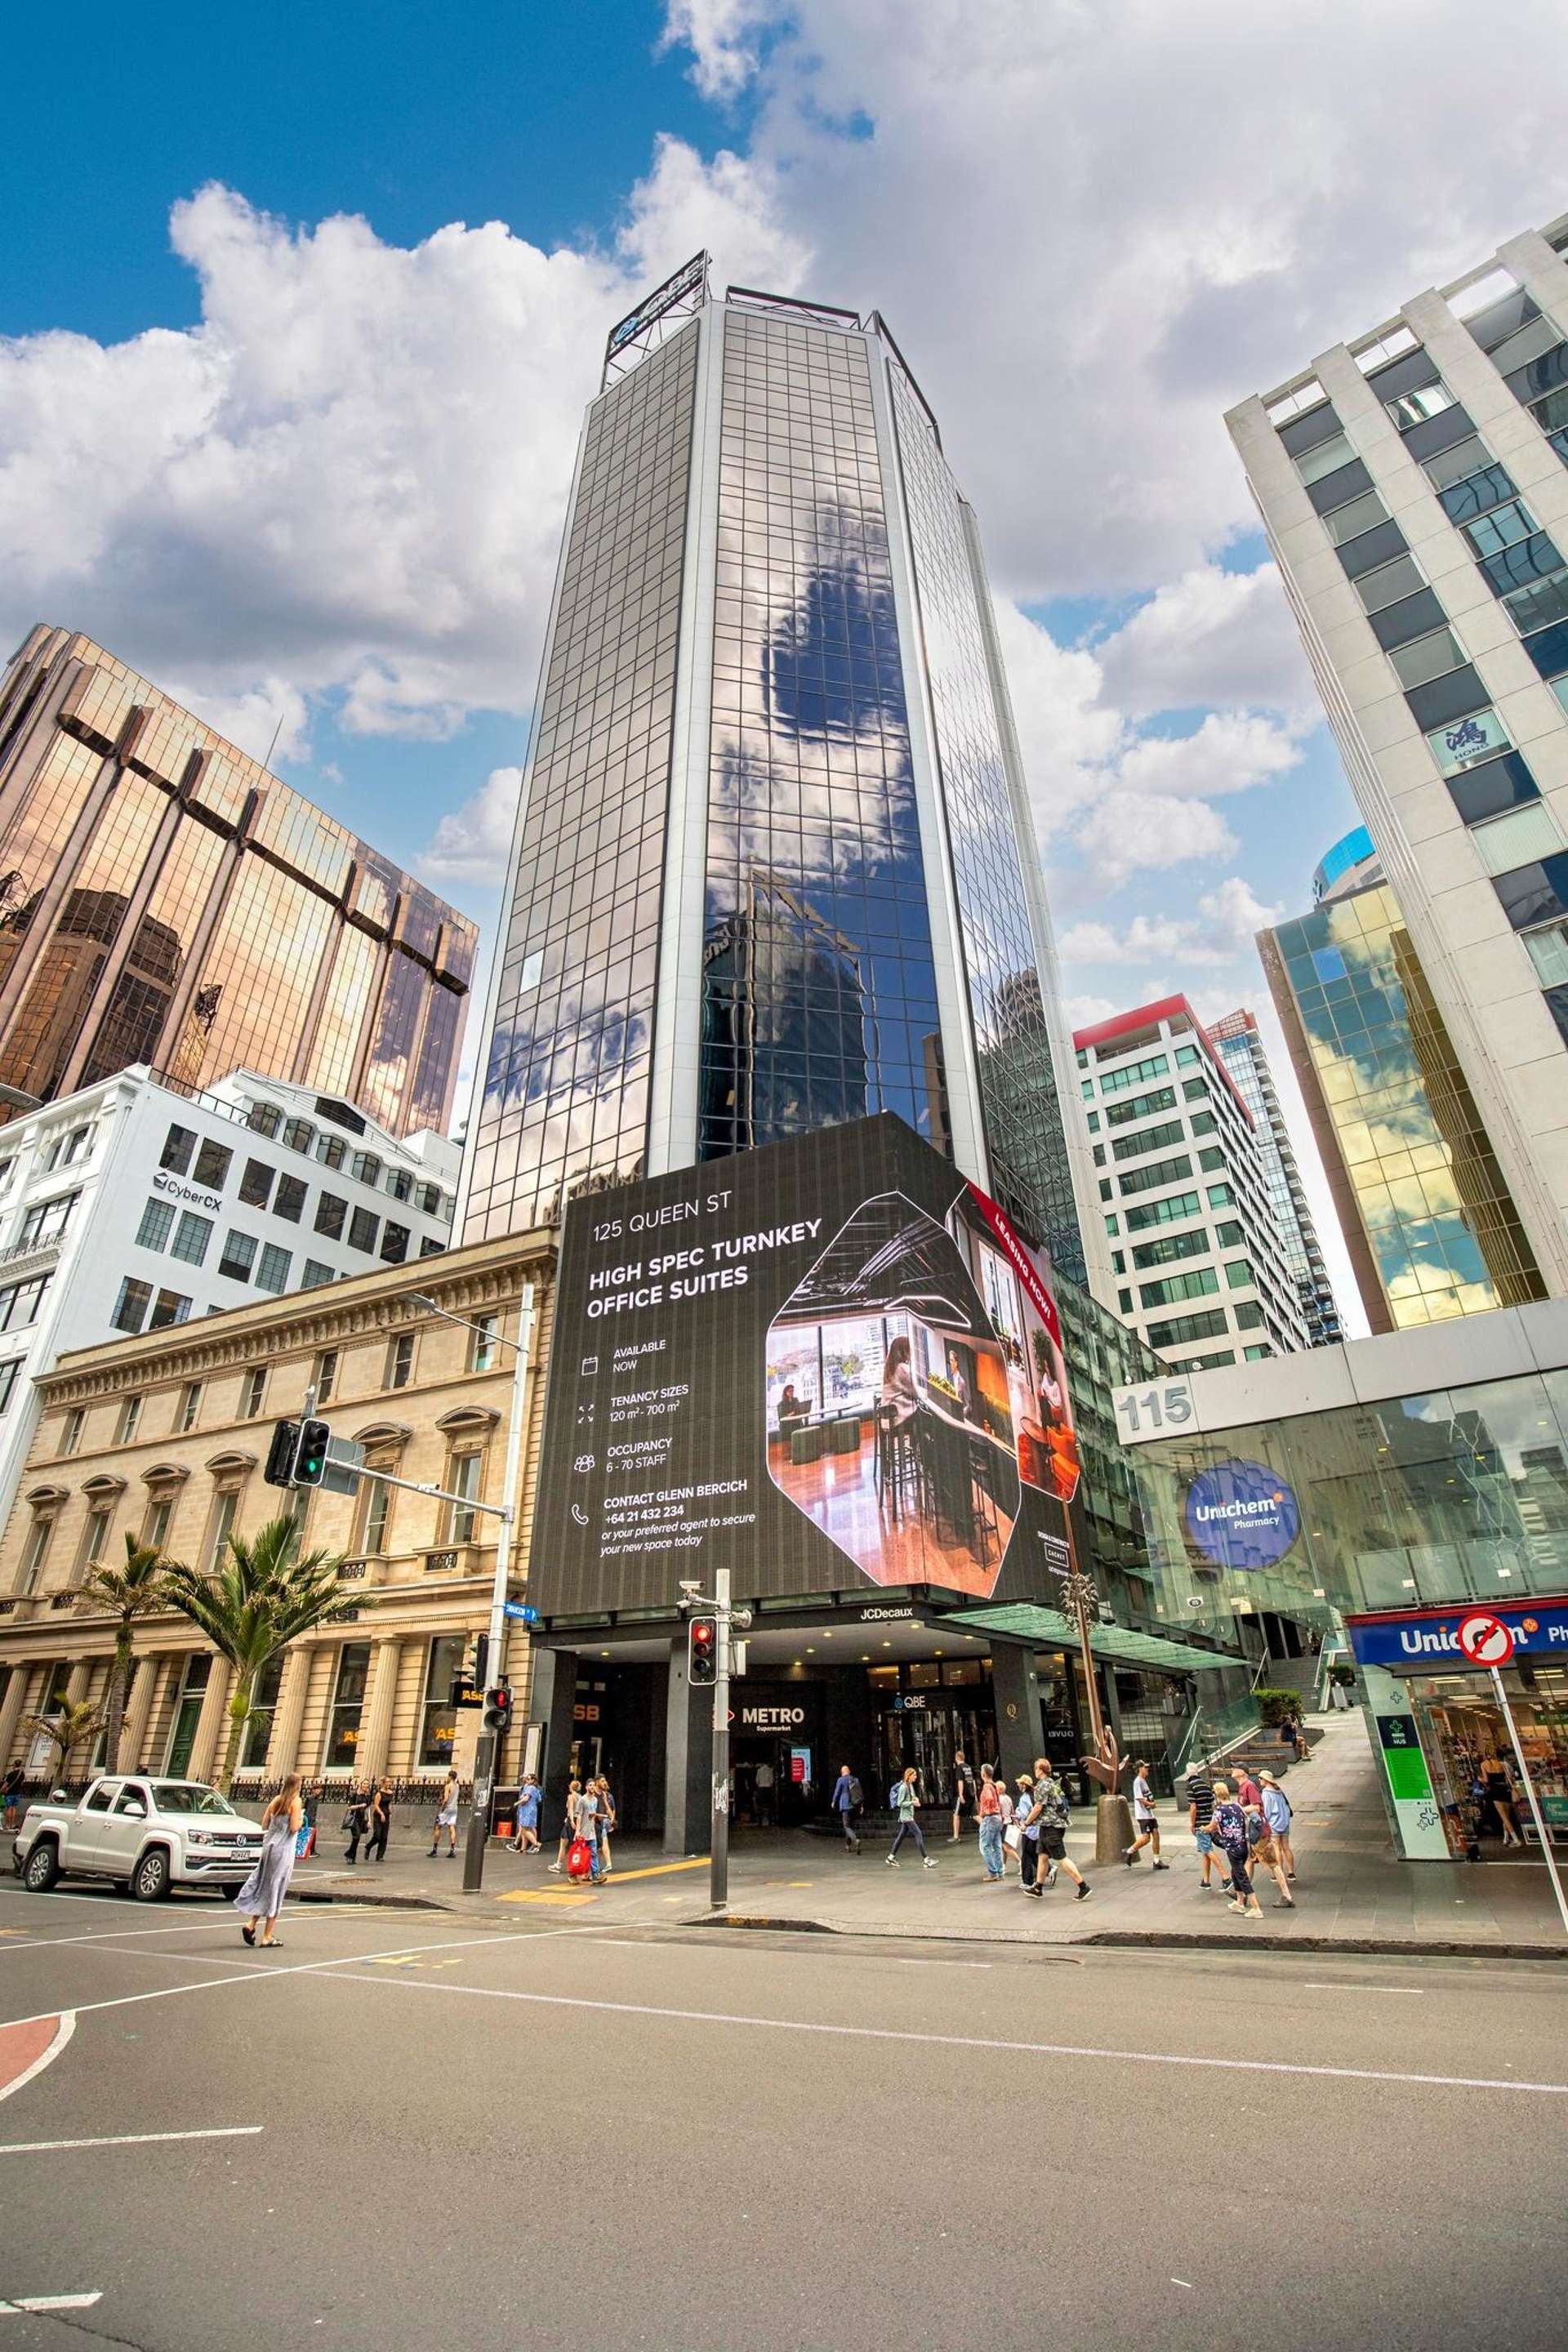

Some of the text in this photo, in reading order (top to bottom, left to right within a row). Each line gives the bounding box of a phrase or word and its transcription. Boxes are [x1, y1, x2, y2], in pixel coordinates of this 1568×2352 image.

[167, 1181, 223, 1212] CyberCX
[593, 1191, 733, 1241] 125 QUEEN ST
[589, 1218, 822, 1290] HIGH SPEC TURNKEY
[995, 1213, 1030, 1278] LEASING
[587, 1266, 749, 1318] OFFICE SUITES
[613, 1339, 667, 1359] AVAILABLE
[612, 1360, 638, 1373] NOW
[611, 1384, 689, 1407] TENANCY SIZES
[610, 1410, 626, 1422] 120
[647, 1404, 665, 1415] 700
[1118, 1386, 1192, 1431] 115
[607, 1437, 673, 1458] OCCUPANCY
[606, 1462, 613, 1472] 6
[621, 1459, 634, 1470] 70
[635, 1454, 667, 1468] STAFF
[604, 1479, 747, 1509] CONTACT GLENN BERCICH
[605, 1505, 684, 1525] +64 21 432 234
[1196, 1498, 1276, 1522] Unichem
[601, 1513, 756, 1541] or your preferred agent to secure
[1234, 1516, 1280, 1530] Pharmacy
[600, 1535, 702, 1557] your new space today
[860, 1607, 913, 1620] JCDecaux
[1401, 1624, 1529, 1654] Unicm
[574, 1704, 600, 1721] SB
[903, 1695, 926, 1708] QBE
[742, 1708, 804, 1723] METRO
